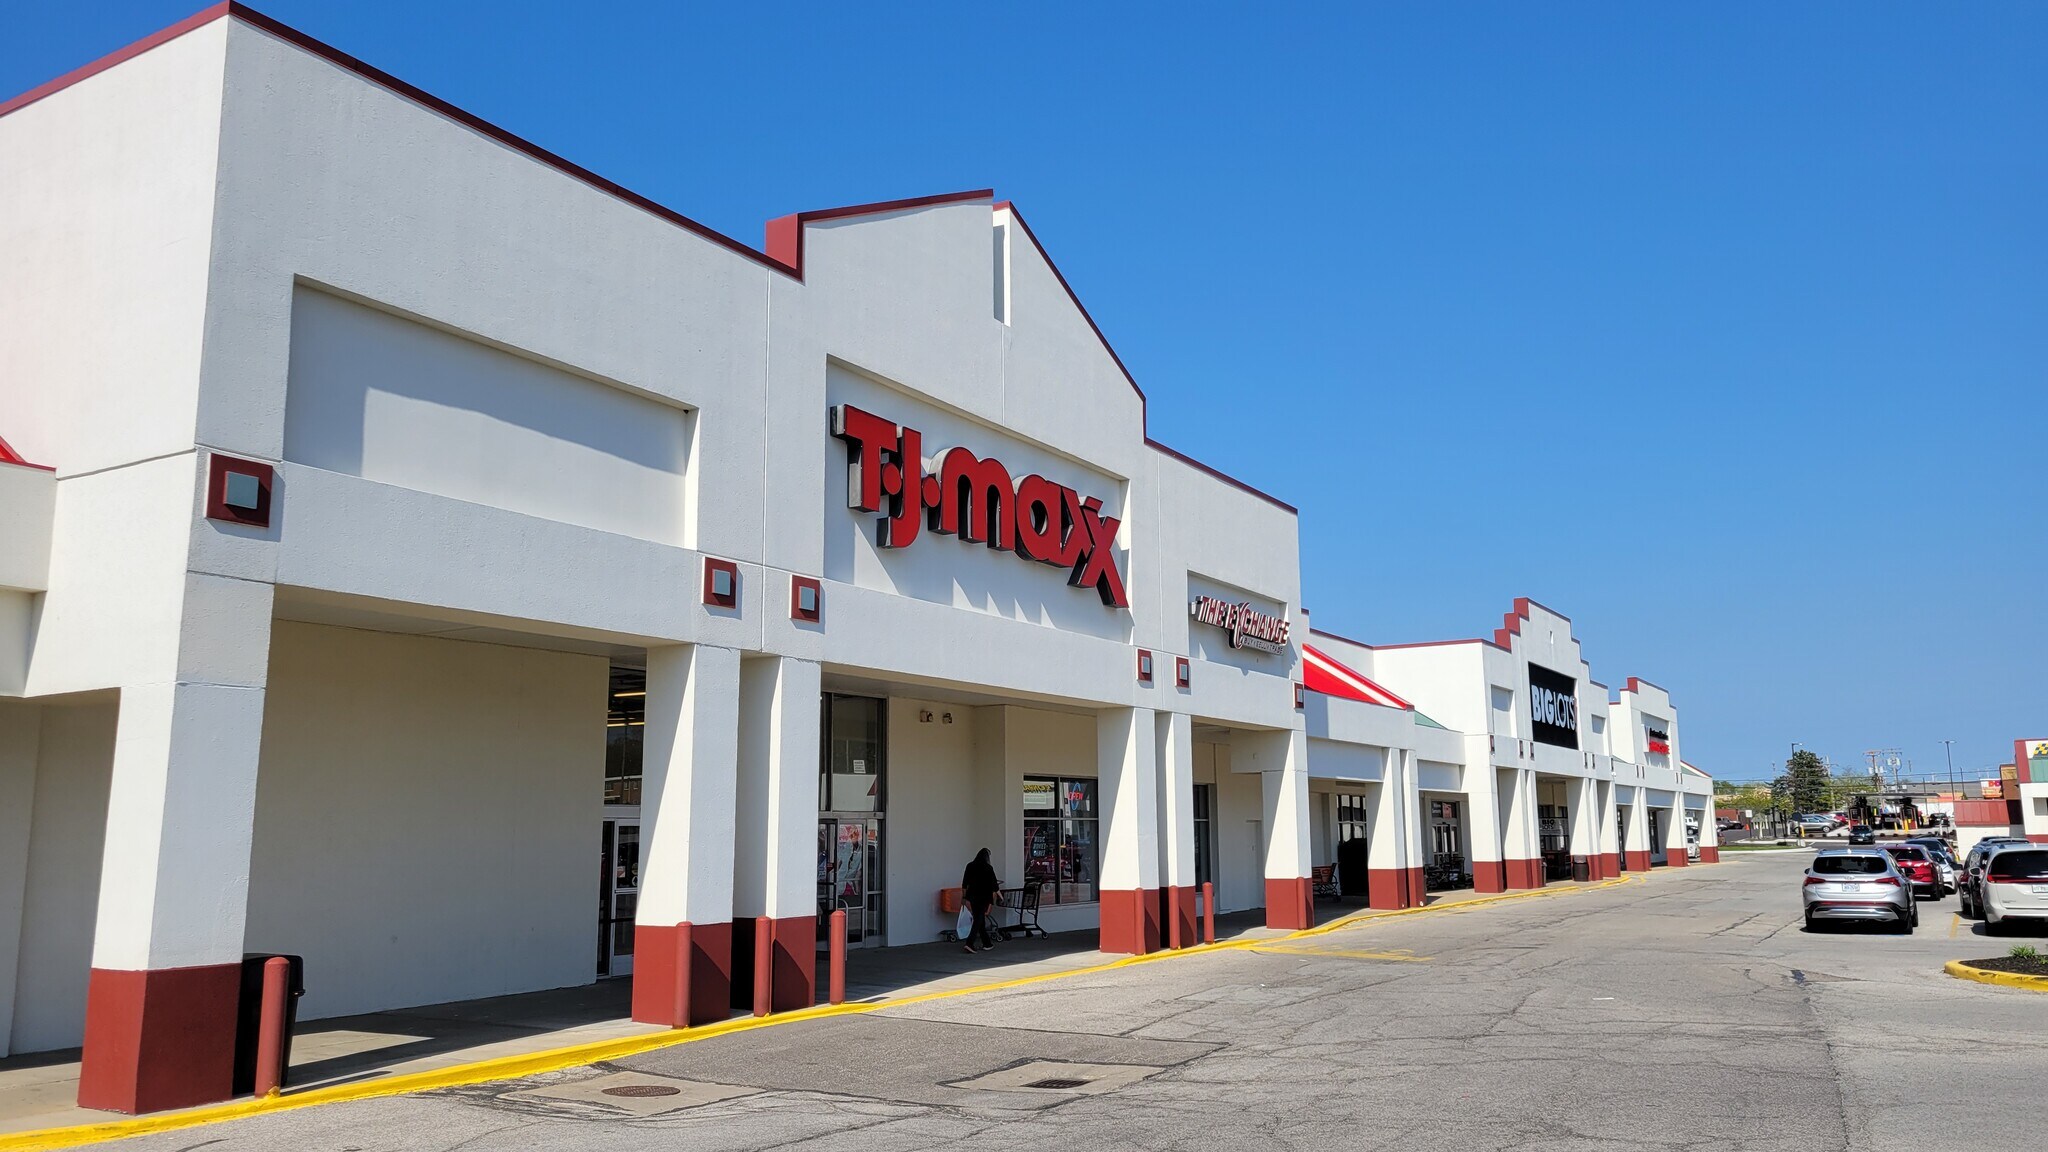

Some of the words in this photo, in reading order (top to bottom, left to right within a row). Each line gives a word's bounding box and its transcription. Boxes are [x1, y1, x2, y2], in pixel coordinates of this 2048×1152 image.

[1197, 595, 1226, 628] THE
[1225, 601, 1290, 649] EXCHANGE
[1531, 684, 1554, 725] BIG
[1554, 691, 1576, 730] LOTS
[1068, 791, 1084, 801] OPEN
